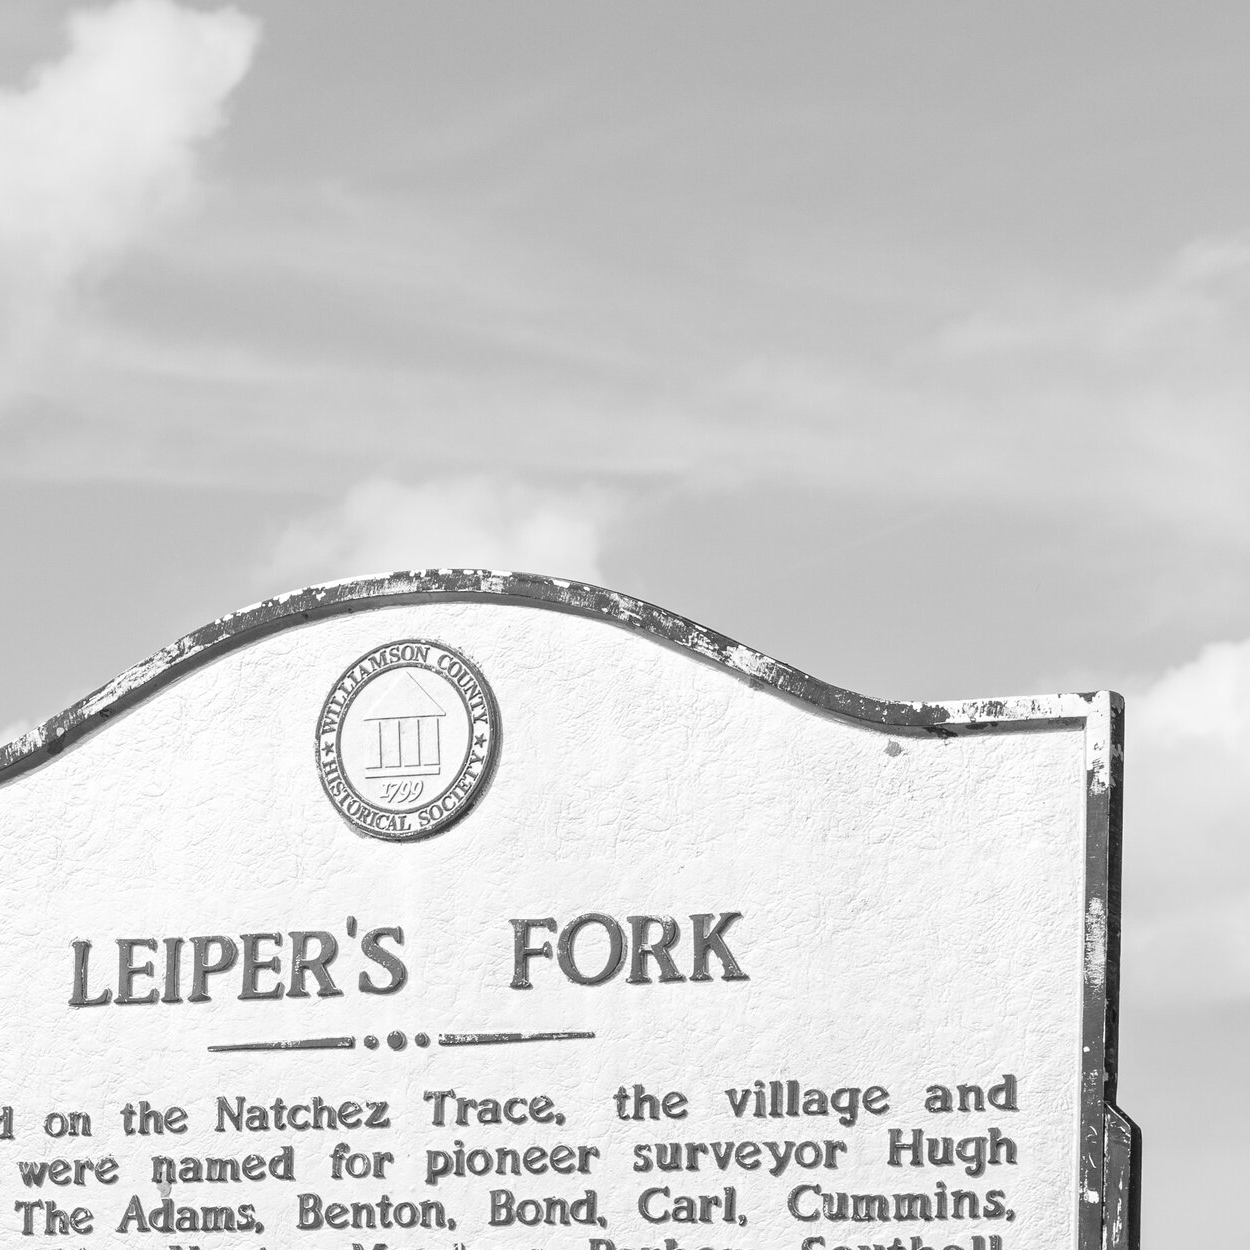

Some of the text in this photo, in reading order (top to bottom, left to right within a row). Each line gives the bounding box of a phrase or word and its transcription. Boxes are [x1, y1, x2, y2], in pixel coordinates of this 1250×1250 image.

[321, 645, 488, 735] WILLIAMSON COUNTY
[322, 750, 485, 831] HISTORICAL SOCIETY
[380, 780, 424, 803] 1799
[69, 912, 749, 1009] LEIPER'S FORK
[44, 1113, 92, 1138] on
[120, 1101, 188, 1136] the
[215, 1097, 390, 1132] Natchez
[424, 1089, 565, 1126] Trace,
[613, 1085, 688, 1120] the
[725, 1080, 889, 1127] village
[925, 1074, 1019, 1113] and
[19, 1158, 119, 1187] were
[152, 1146, 295, 1185] named
[330, 1143, 394, 1179] for
[425, 1140, 600, 1185] pioneer
[633, 1141, 847, 1177] surveyor
[887, 1128, 1017, 1177] Hugh
[15, 1199, 93, 1236] The
[116, 1195, 264, 1234] Adams,
[296, 1194, 456, 1230] Benton,
[488, 1190, 607, 1228] Bond,
[638, 1186, 747, 1226] Carl,
[788, 1182, 1016, 1222] Cummins,
